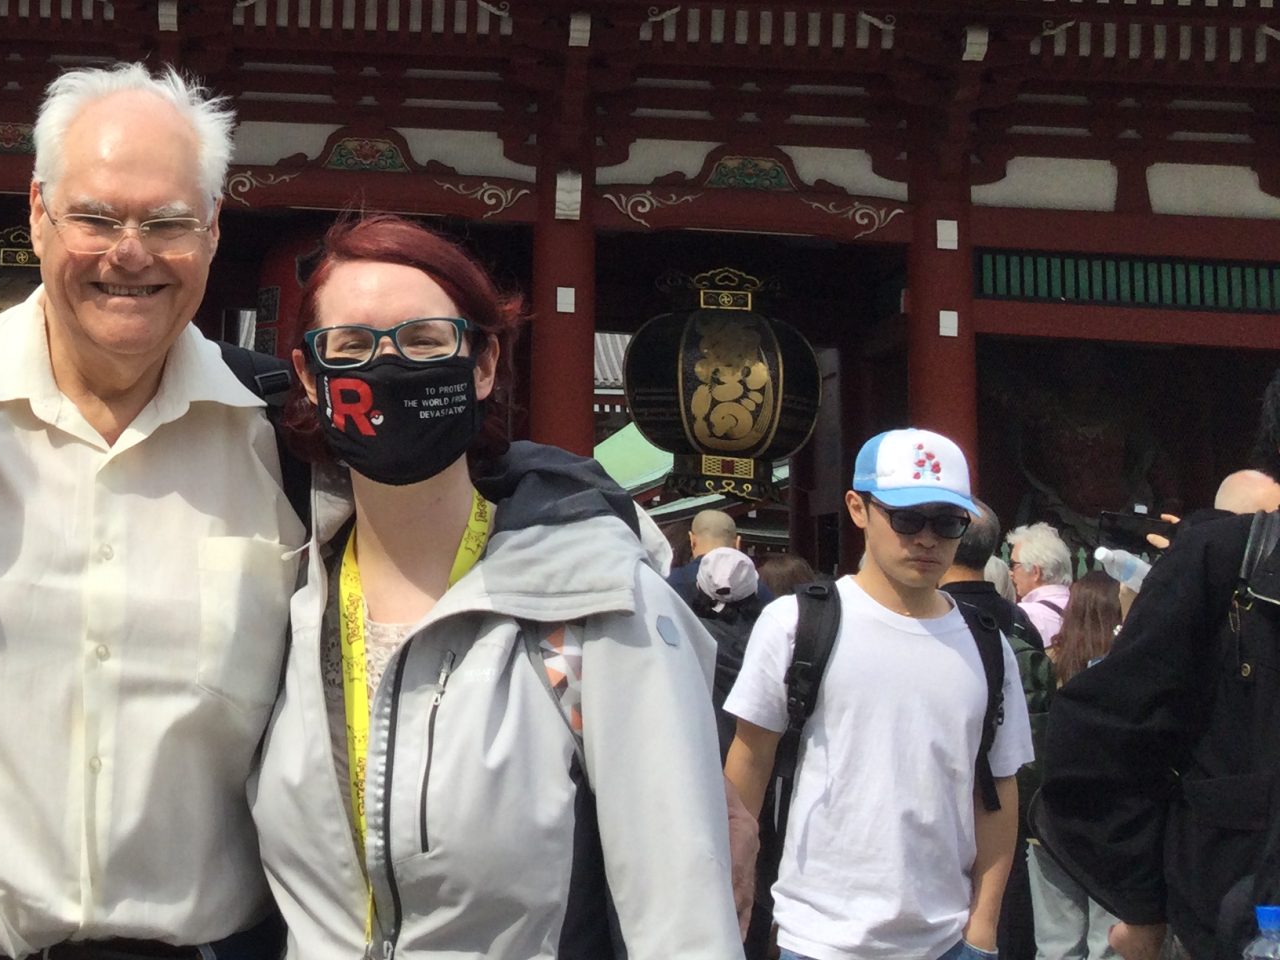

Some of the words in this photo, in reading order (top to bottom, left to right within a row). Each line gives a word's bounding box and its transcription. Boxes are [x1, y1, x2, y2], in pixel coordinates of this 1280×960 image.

[425, 387, 436, 395] TO
[439, 382, 468, 394] PROTECT
[330, 377, 377, 436] R
[404, 399, 418, 408] THE
[422, 397, 449, 407] WORLD
[419, 405, 466, 419] DEVASTATIO
